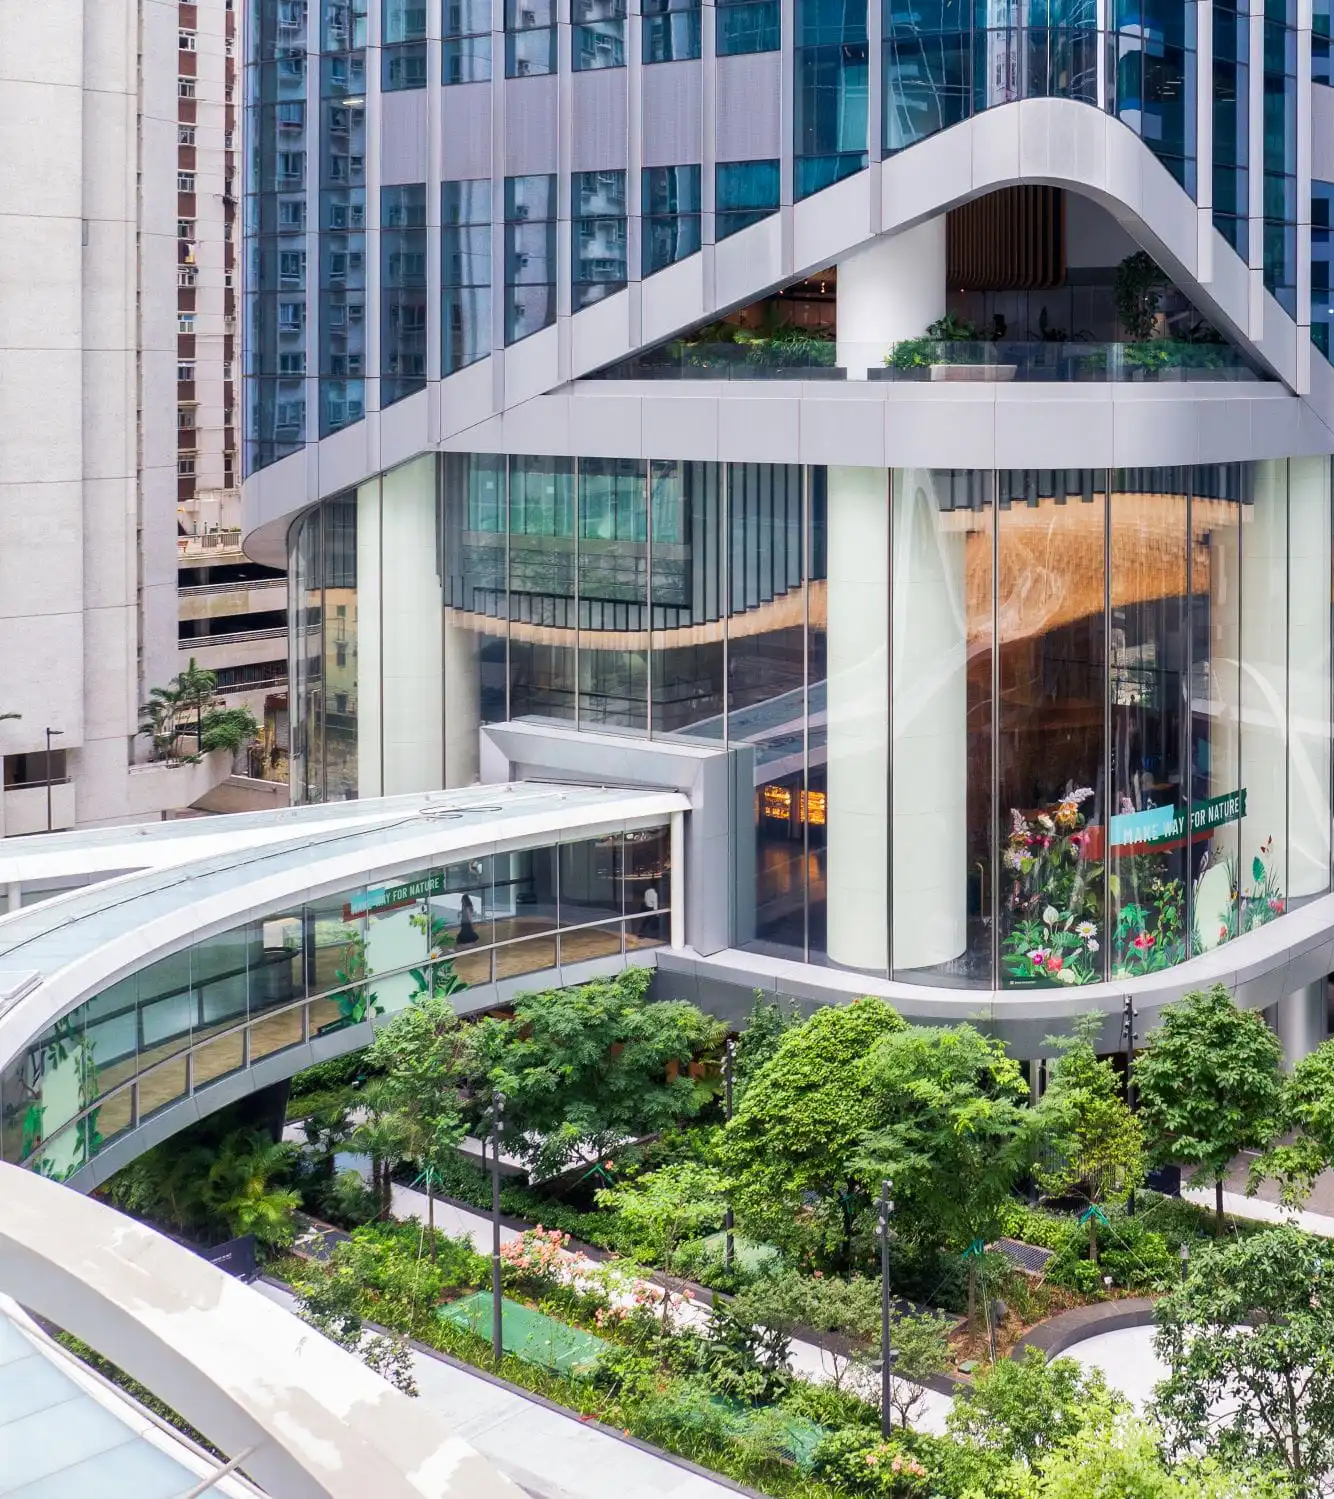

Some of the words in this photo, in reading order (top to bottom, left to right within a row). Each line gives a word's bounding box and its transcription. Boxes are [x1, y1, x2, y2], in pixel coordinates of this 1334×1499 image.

[1123, 824, 1159, 845] MAKE
[1163, 817, 1185, 838] WAY
[1190, 809, 1206, 829] FOR
[1208, 797, 1239, 822] NATURE
[393, 887, 408, 902] FOR
[409, 877, 440, 896] NATURE
